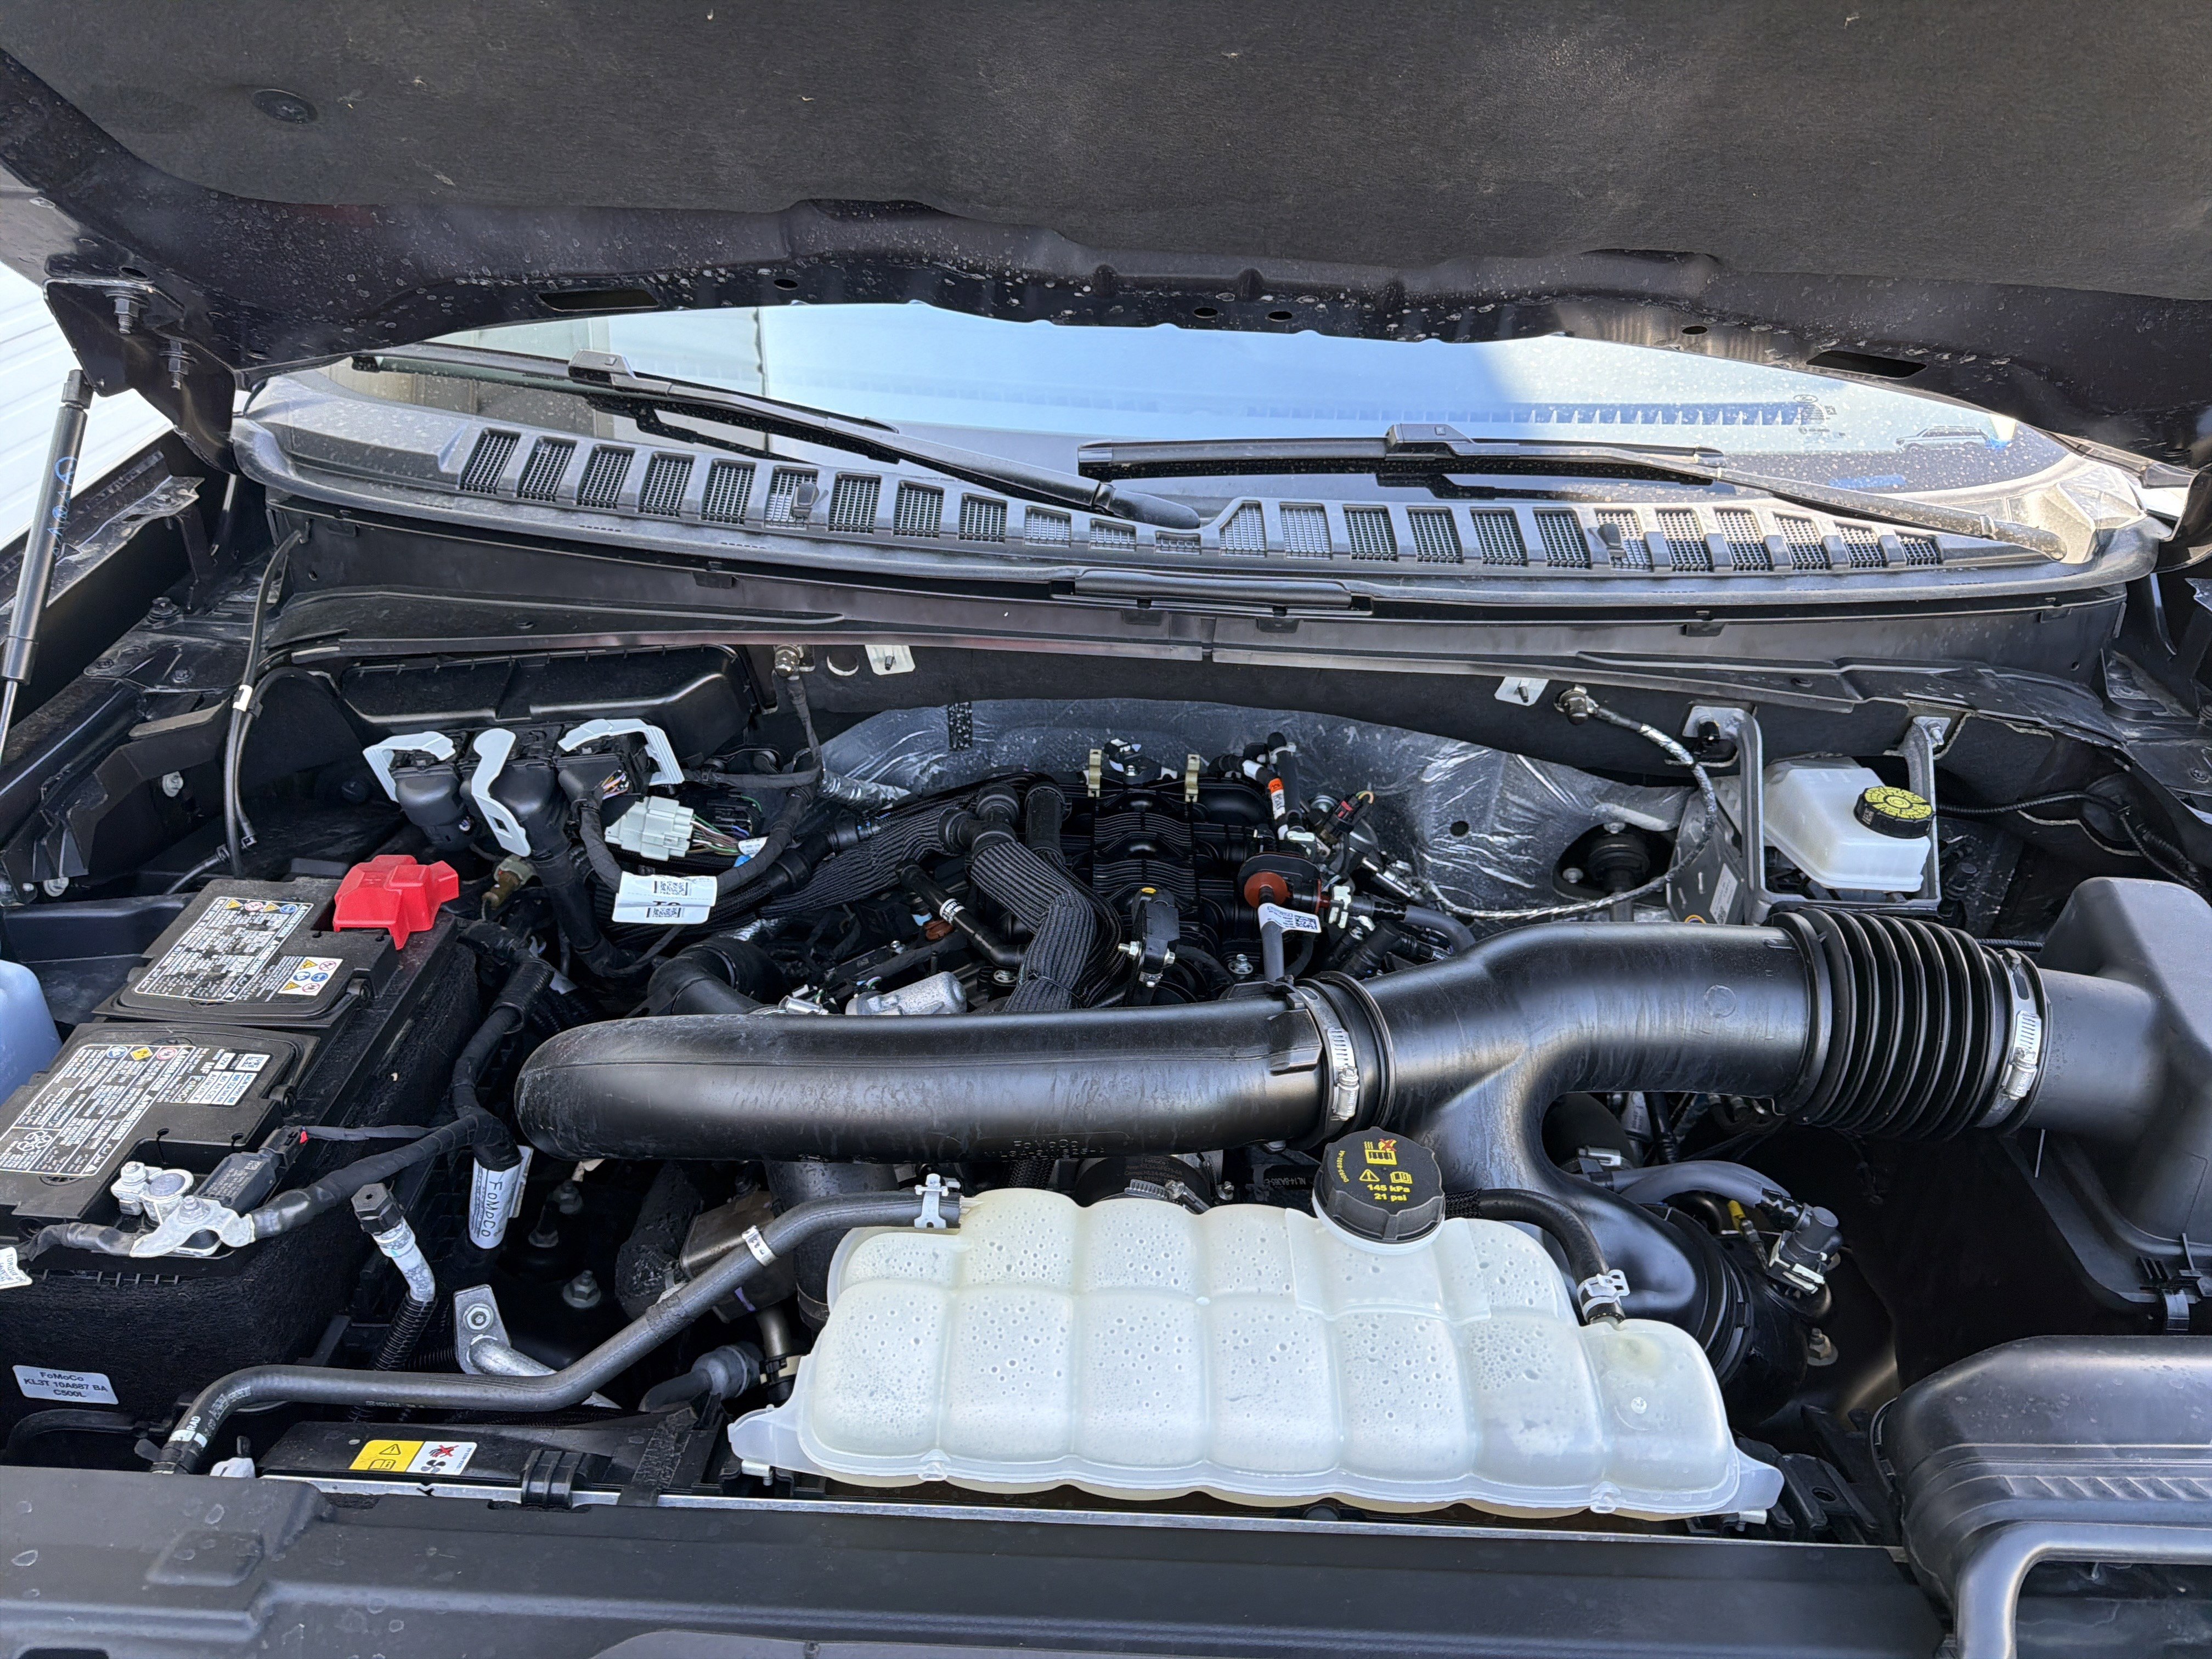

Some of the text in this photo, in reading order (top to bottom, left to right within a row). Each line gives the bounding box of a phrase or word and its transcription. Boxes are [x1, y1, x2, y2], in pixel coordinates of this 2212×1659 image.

[218, 1057, 231, 1065] 12V
[197, 1062, 216, 1074] MF
[173, 1077, 201, 1102] FoMoCo
[40, 1372, 84, 1381] FoMoCo
[186, 1415, 201, 1431] RAD
